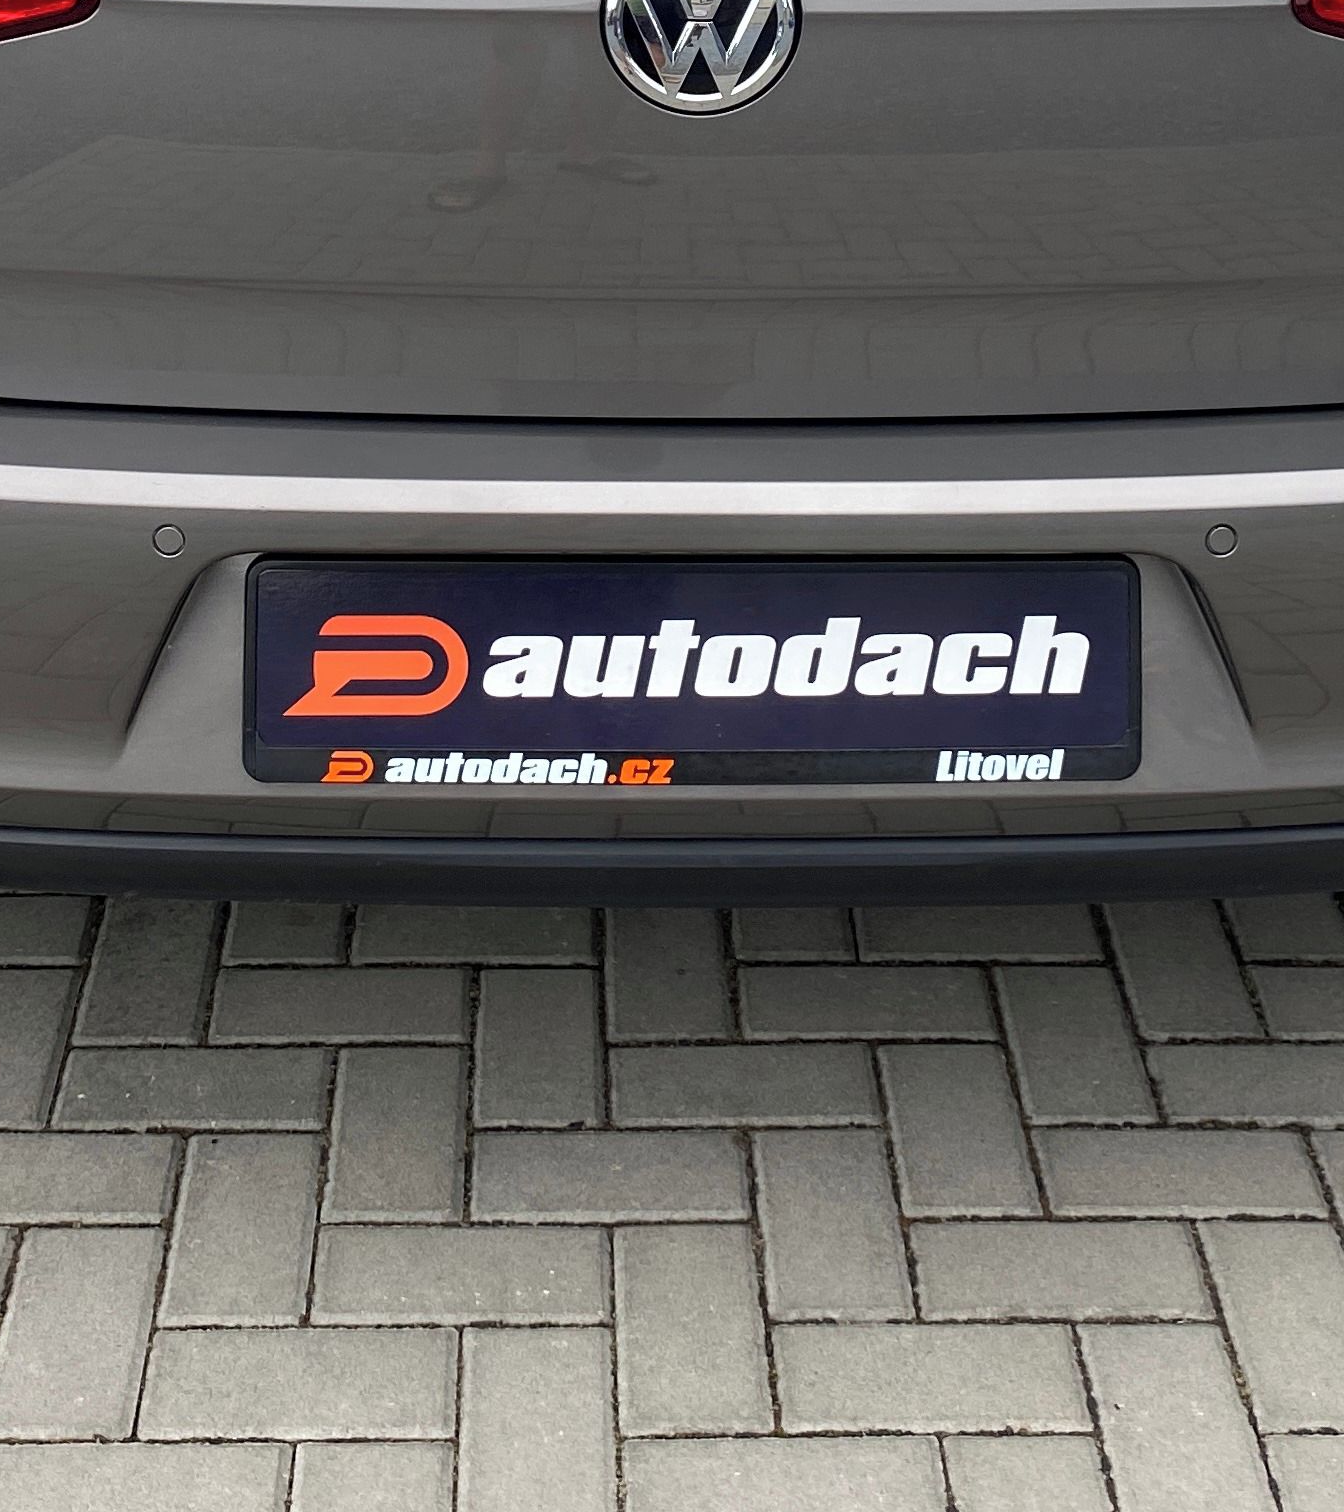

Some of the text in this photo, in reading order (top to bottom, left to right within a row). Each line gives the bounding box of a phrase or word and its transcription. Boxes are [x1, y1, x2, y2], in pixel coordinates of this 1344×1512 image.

[483, 615, 1091, 698] autodach
[384, 748, 1065, 784] autodach.cz Litovel
